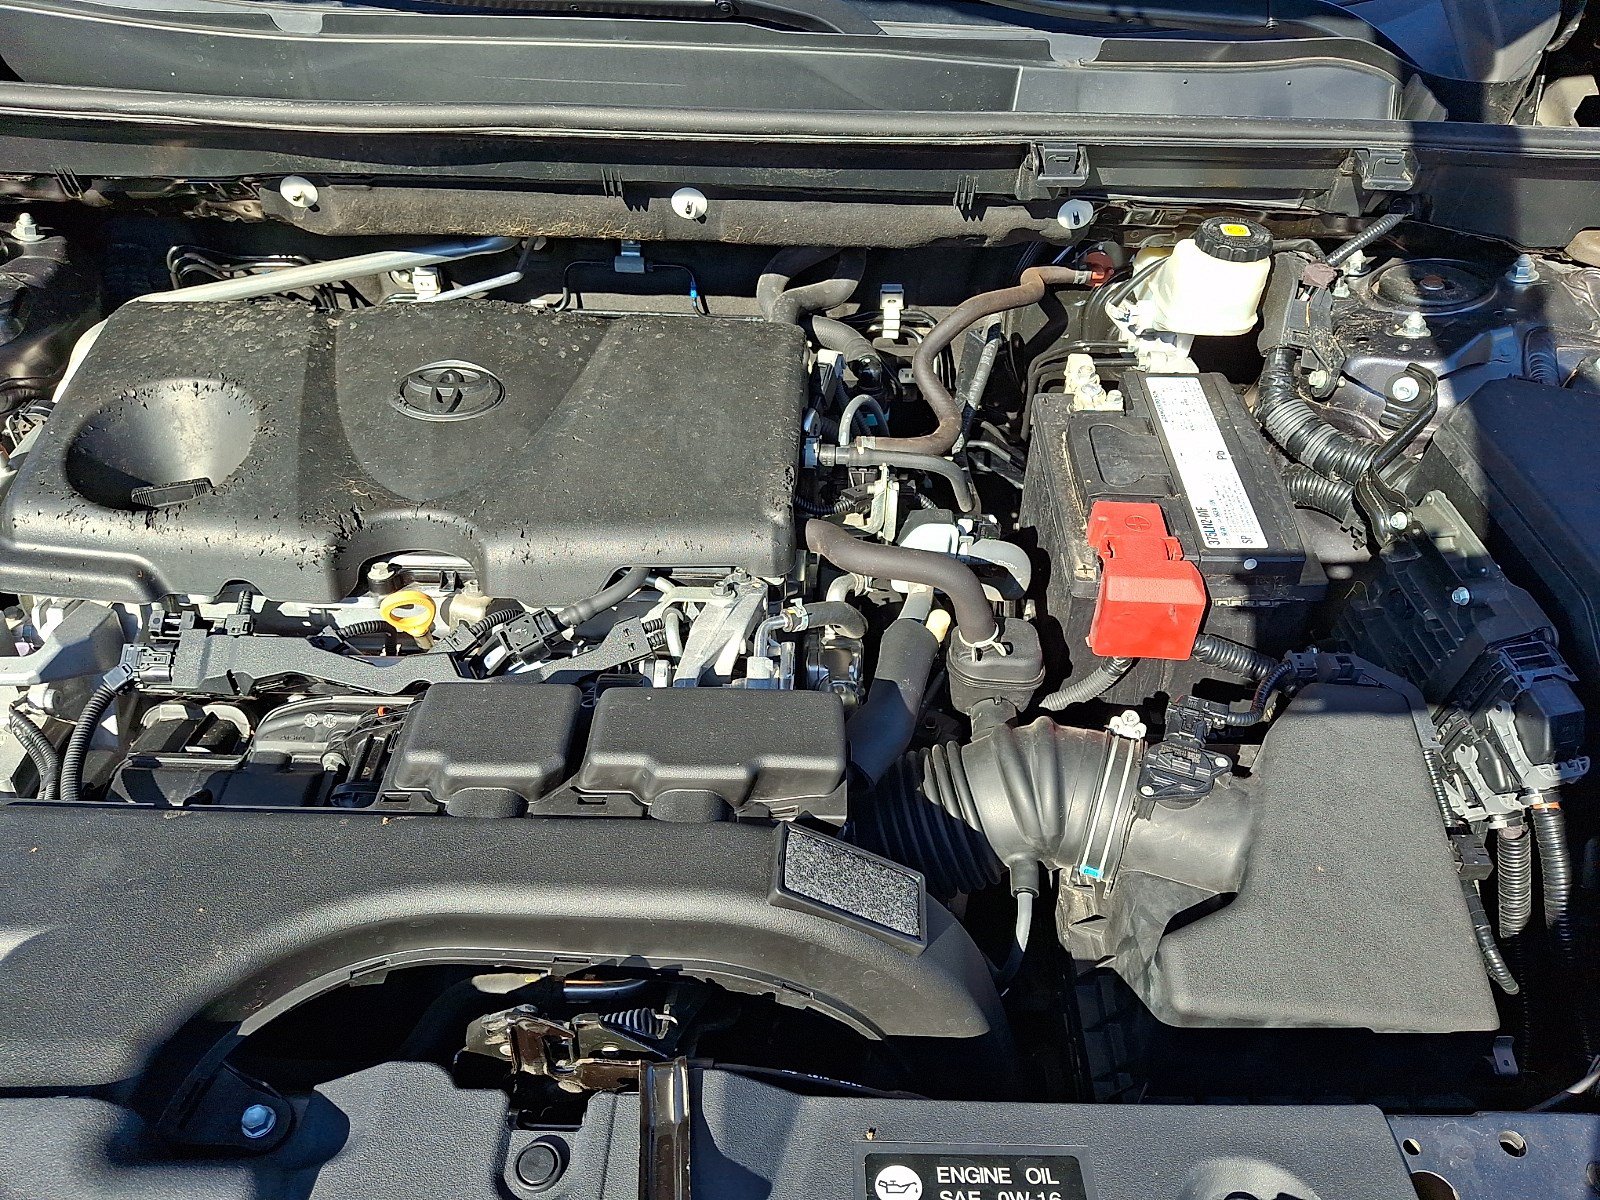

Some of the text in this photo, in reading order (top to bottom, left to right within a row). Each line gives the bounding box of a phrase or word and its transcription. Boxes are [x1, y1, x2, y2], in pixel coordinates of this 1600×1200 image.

[1240, 535, 1254, 544] SP
[936, 1166, 1060, 1185] ENGINE OIL
[940, 1190, 981, 1200] SAE
